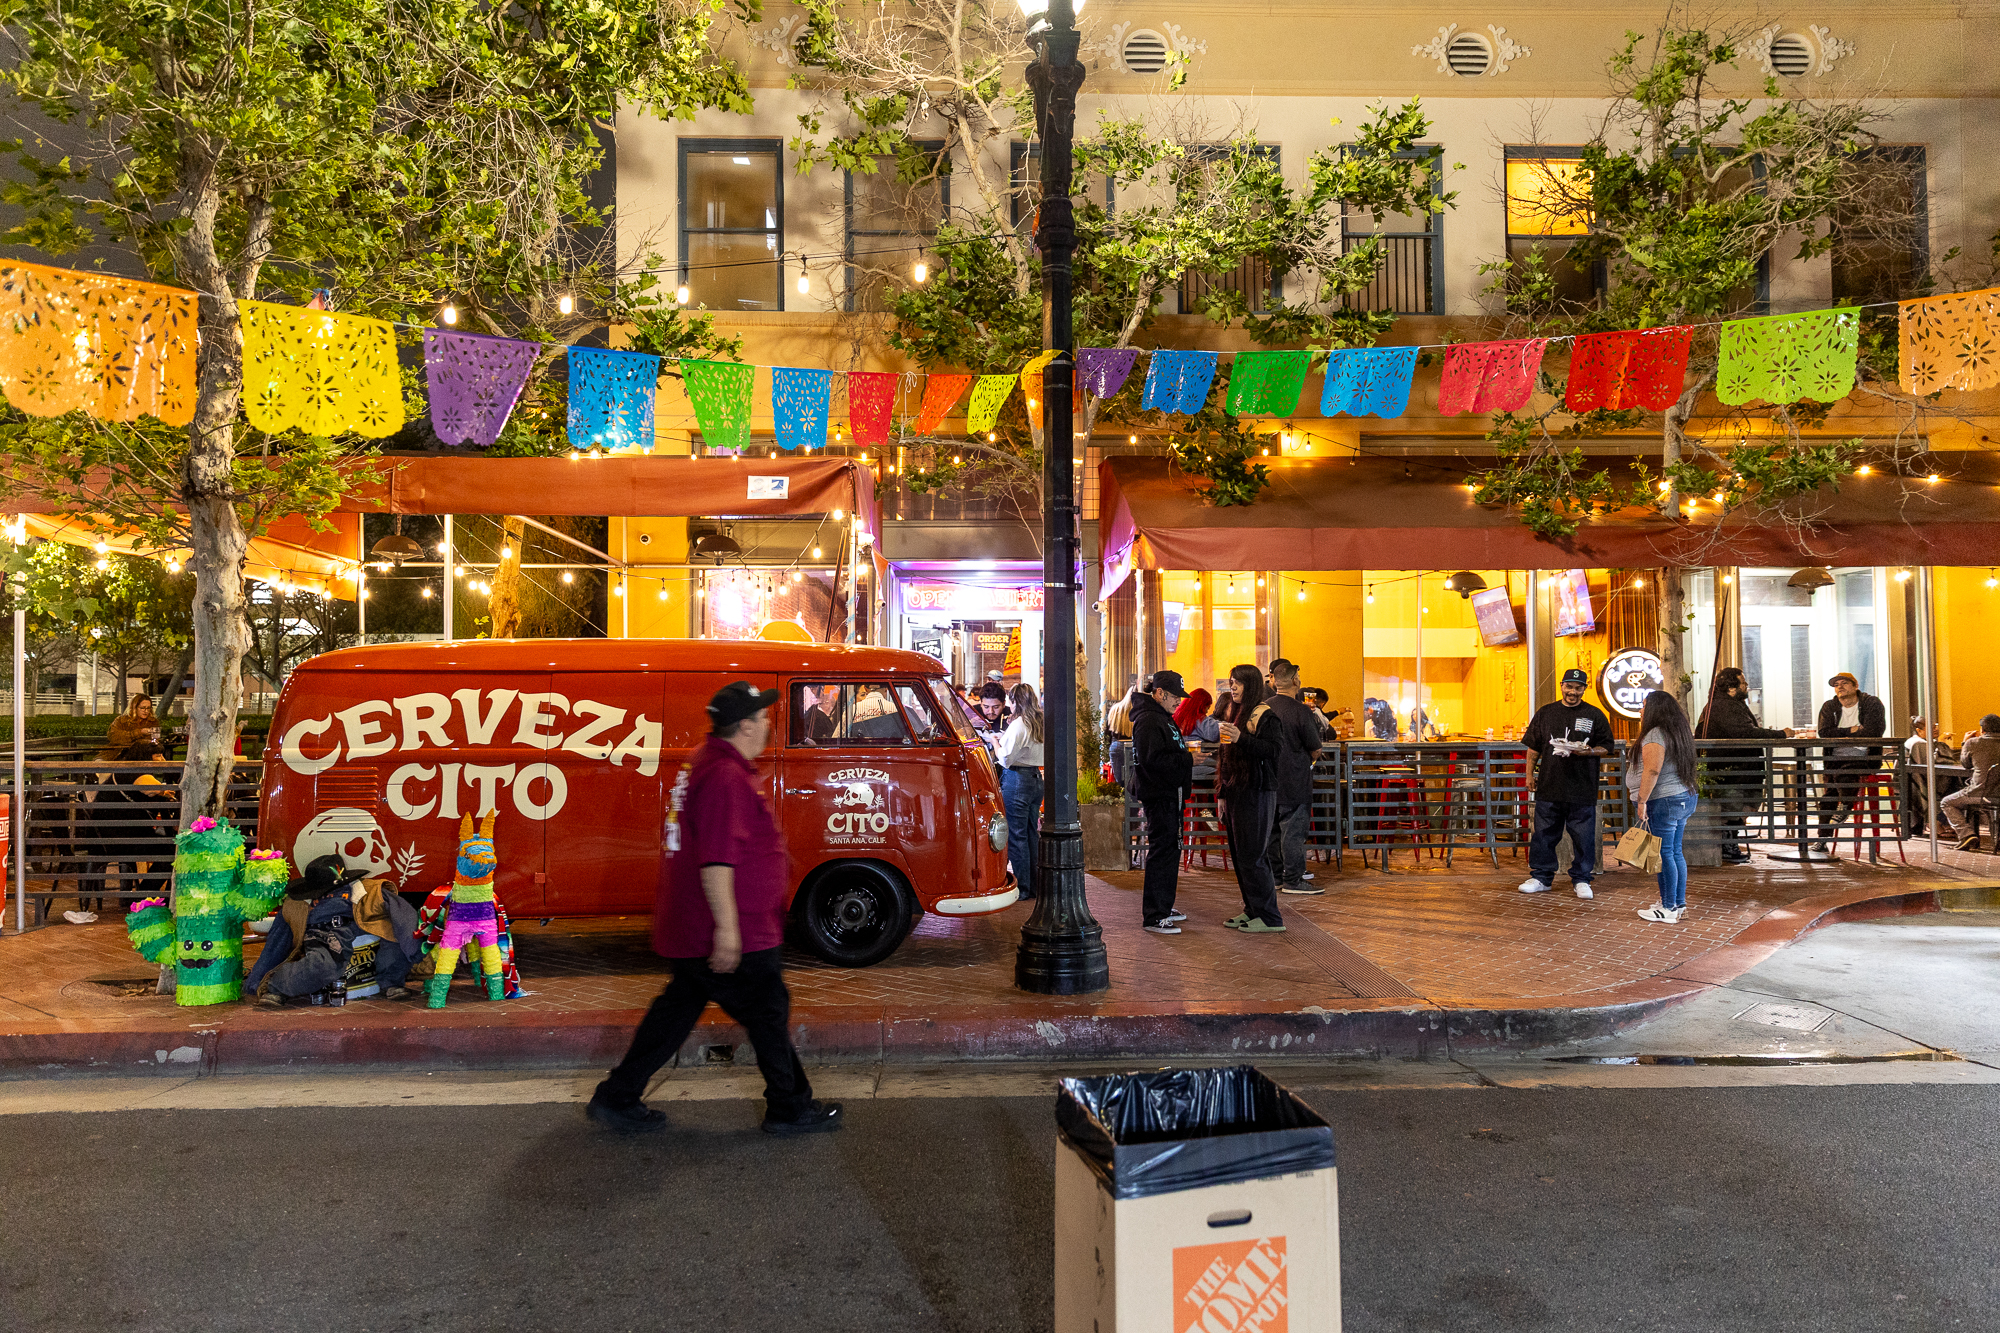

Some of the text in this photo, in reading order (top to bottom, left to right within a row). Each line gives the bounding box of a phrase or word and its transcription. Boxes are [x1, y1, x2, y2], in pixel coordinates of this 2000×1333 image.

[986, 590, 1043, 608] ABIERT
[977, 634, 1010, 644] ORDER
[980, 642, 1006, 651] HERE
[1573, 670, 1580, 678] S
[1606, 656, 1665, 685] SABOR
[280, 688, 663, 777] CERVEZA
[828, 768, 889, 783] CERVEZA
[386, 762, 568, 821] CITO
[827, 812, 890, 833] CITO
[867, 836, 887, 844] CALIF.
[1183, 1255, 1232, 1310] THE
